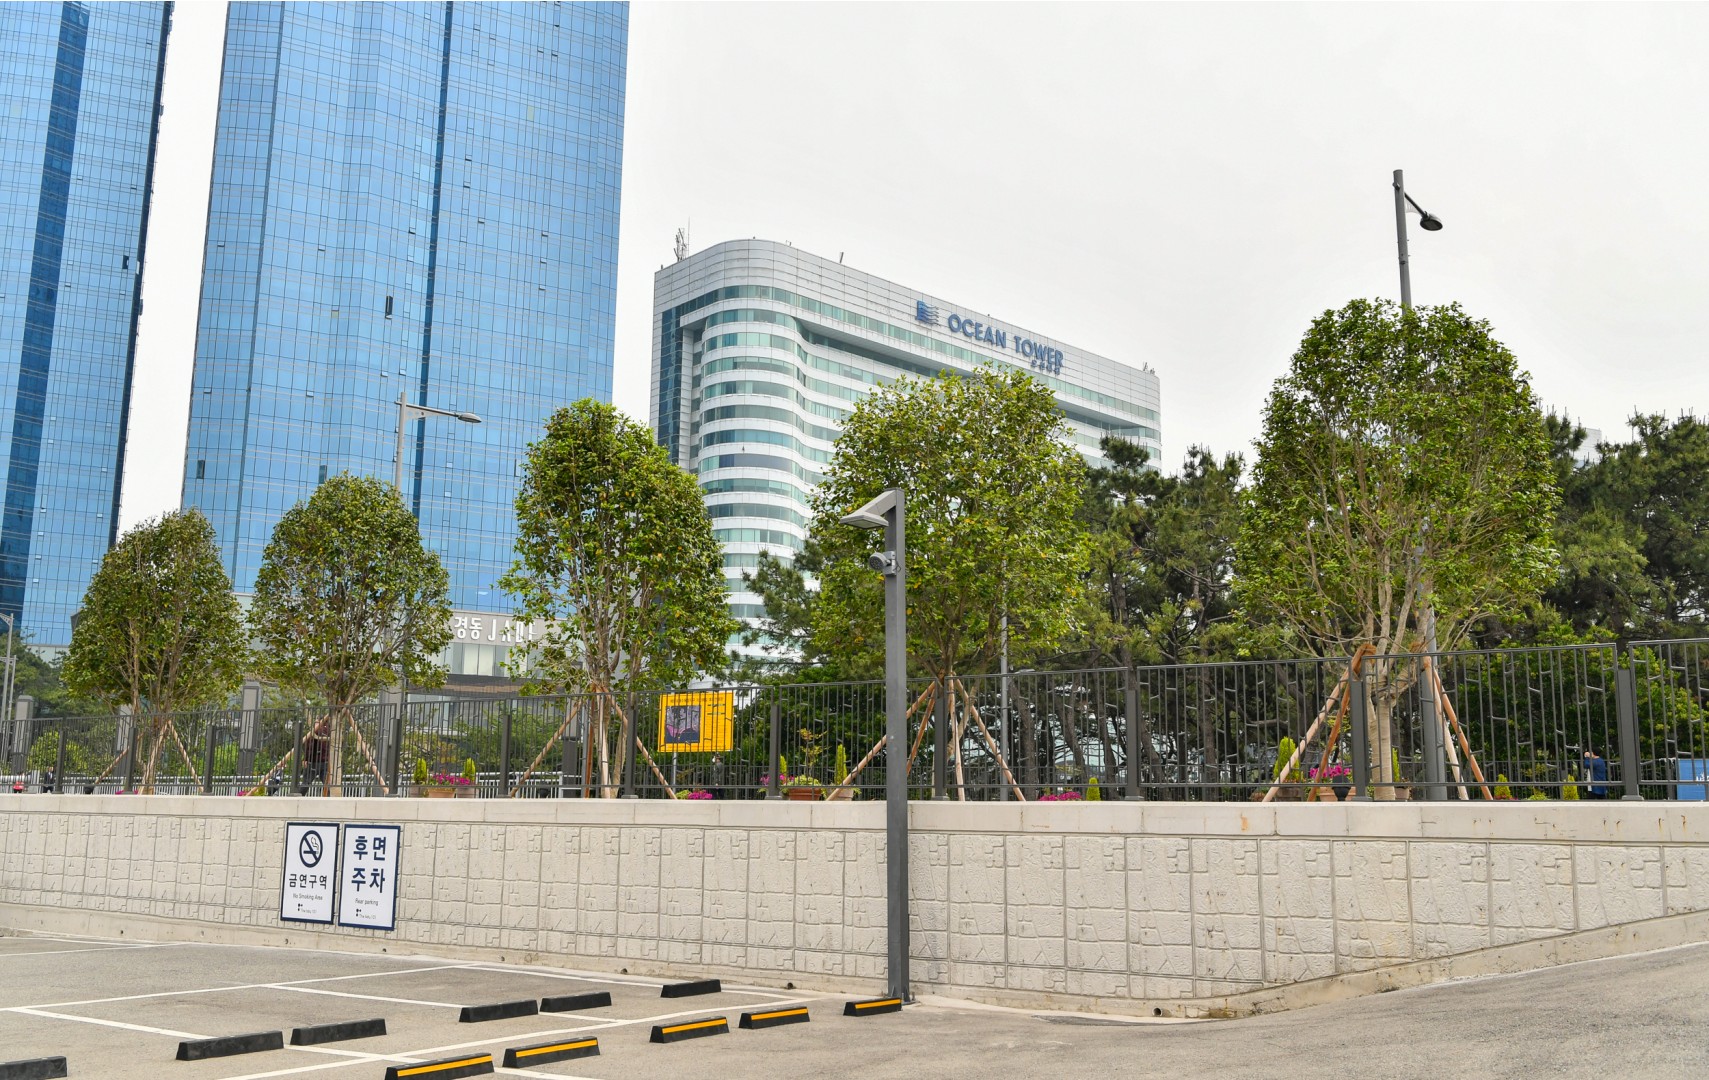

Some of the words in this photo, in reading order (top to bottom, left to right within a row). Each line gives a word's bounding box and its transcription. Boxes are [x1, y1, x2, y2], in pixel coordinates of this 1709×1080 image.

[948, 314, 1006, 348] OCEAN
[1014, 335, 1064, 368] TOWER
[454, 616, 483, 639] 경동
[353, 835, 386, 861] 후면
[289, 873, 327, 890] 금연구역
[351, 867, 386, 894] 주차
[299, 893, 314, 901] Smoking
